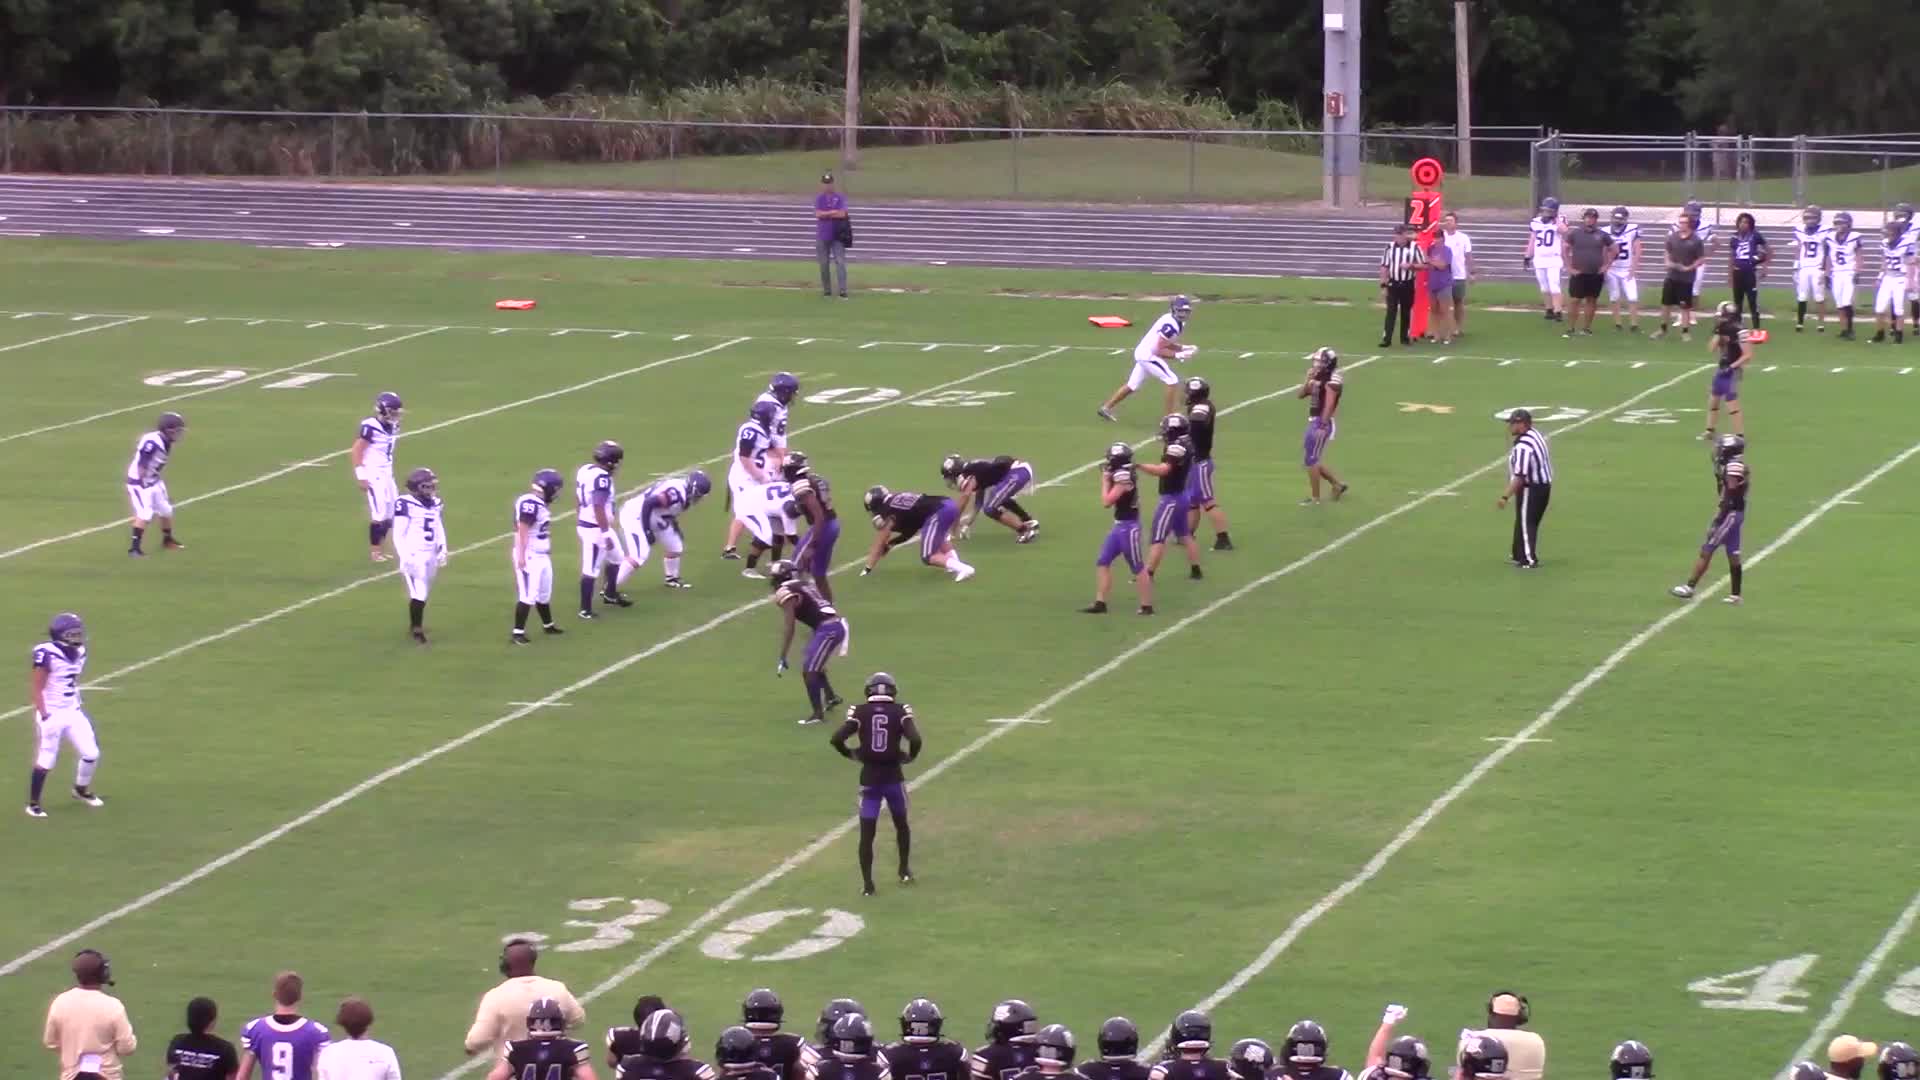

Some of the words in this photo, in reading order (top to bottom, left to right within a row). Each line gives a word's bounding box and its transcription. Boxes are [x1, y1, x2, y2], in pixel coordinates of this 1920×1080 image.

[1409, 200, 1425, 225] 2
[1536, 229, 1555, 248] 50
[743, 430, 755, 440] 57
[522, 502, 536, 513] 99
[424, 517, 434, 542] 5
[34, 651, 45, 663] 3
[872, 714, 888, 752] 6
[271, 1042, 294, 1080] 9
